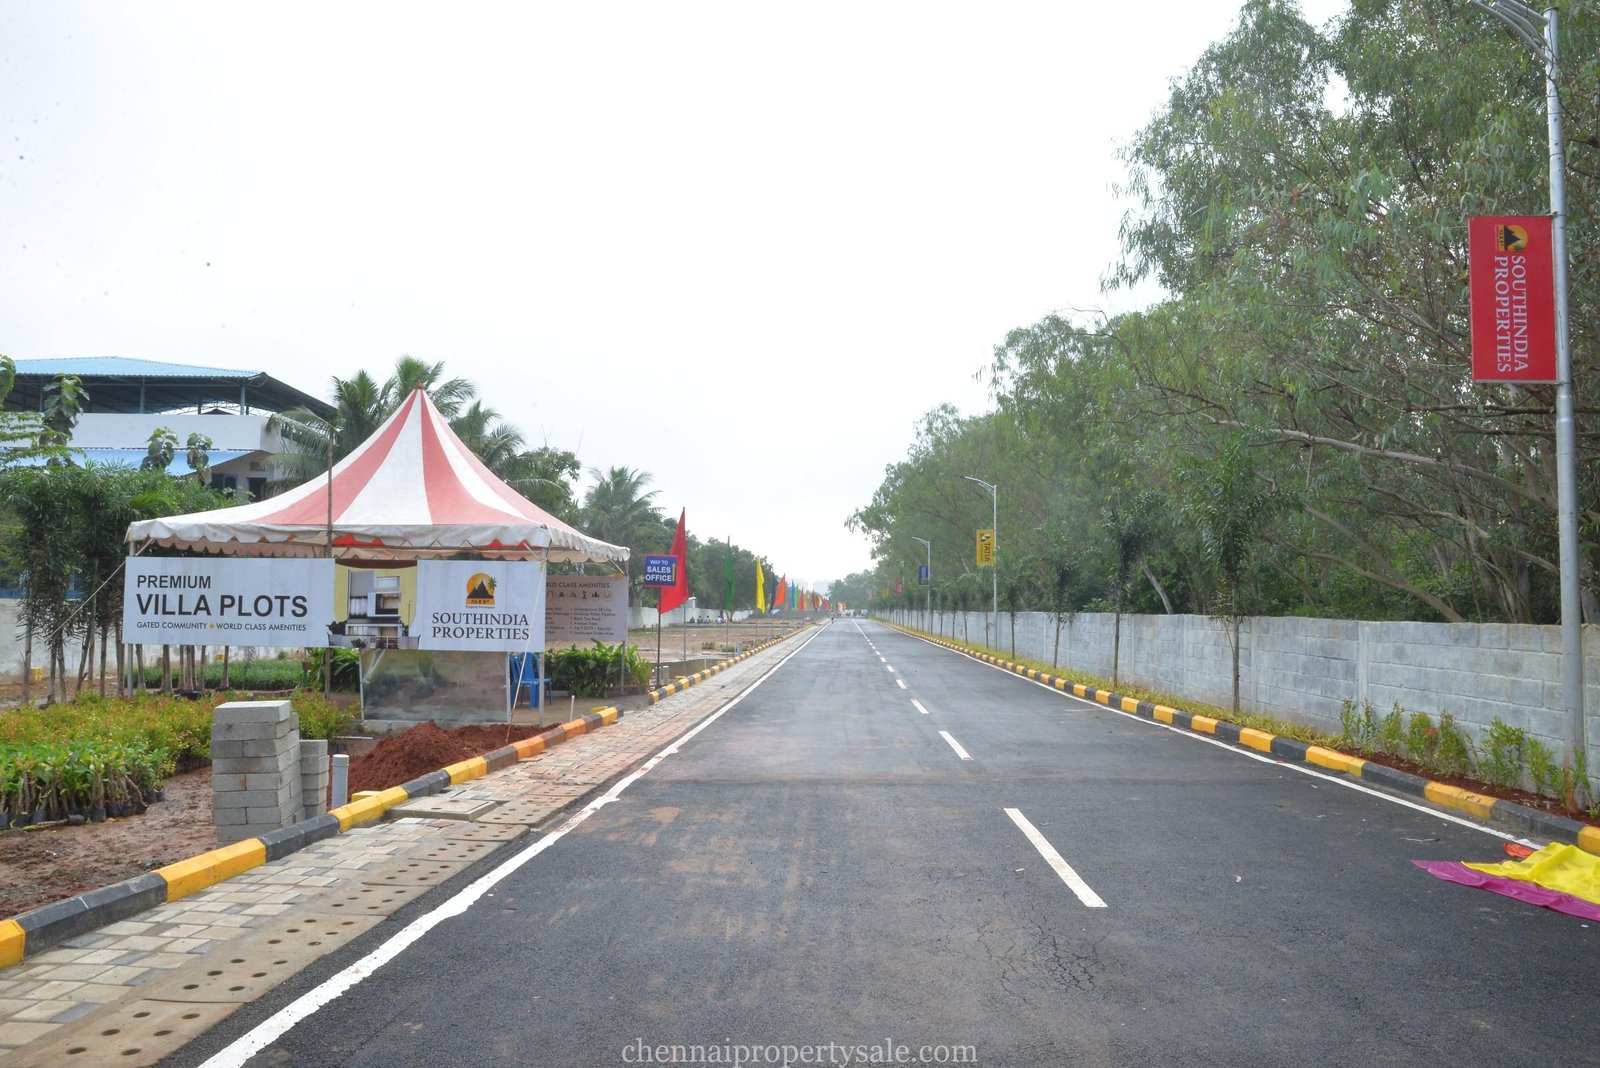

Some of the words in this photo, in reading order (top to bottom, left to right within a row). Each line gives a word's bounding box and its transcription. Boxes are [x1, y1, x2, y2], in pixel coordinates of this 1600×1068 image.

[1494, 255, 1512, 373] PROPERTIES
[1511, 255, 1529, 372] SOUTHINDIA
[646, 565, 671, 574] SALES
[136, 575, 211, 589] PREMIUM
[645, 574, 672, 582] OFFICE
[136, 594, 212, 616] VILLA
[219, 594, 308, 618] PLOTS
[431, 612, 529, 625] SOUTHINDIA
[136, 621, 160, 629] GATED
[161, 621, 208, 630] COMMUNITY
[216, 622, 243, 630] WORLD
[244, 623, 267, 631] CLASS
[267, 623, 307, 631] AMENITIES
[431, 626, 529, 640] PROPERTIES
